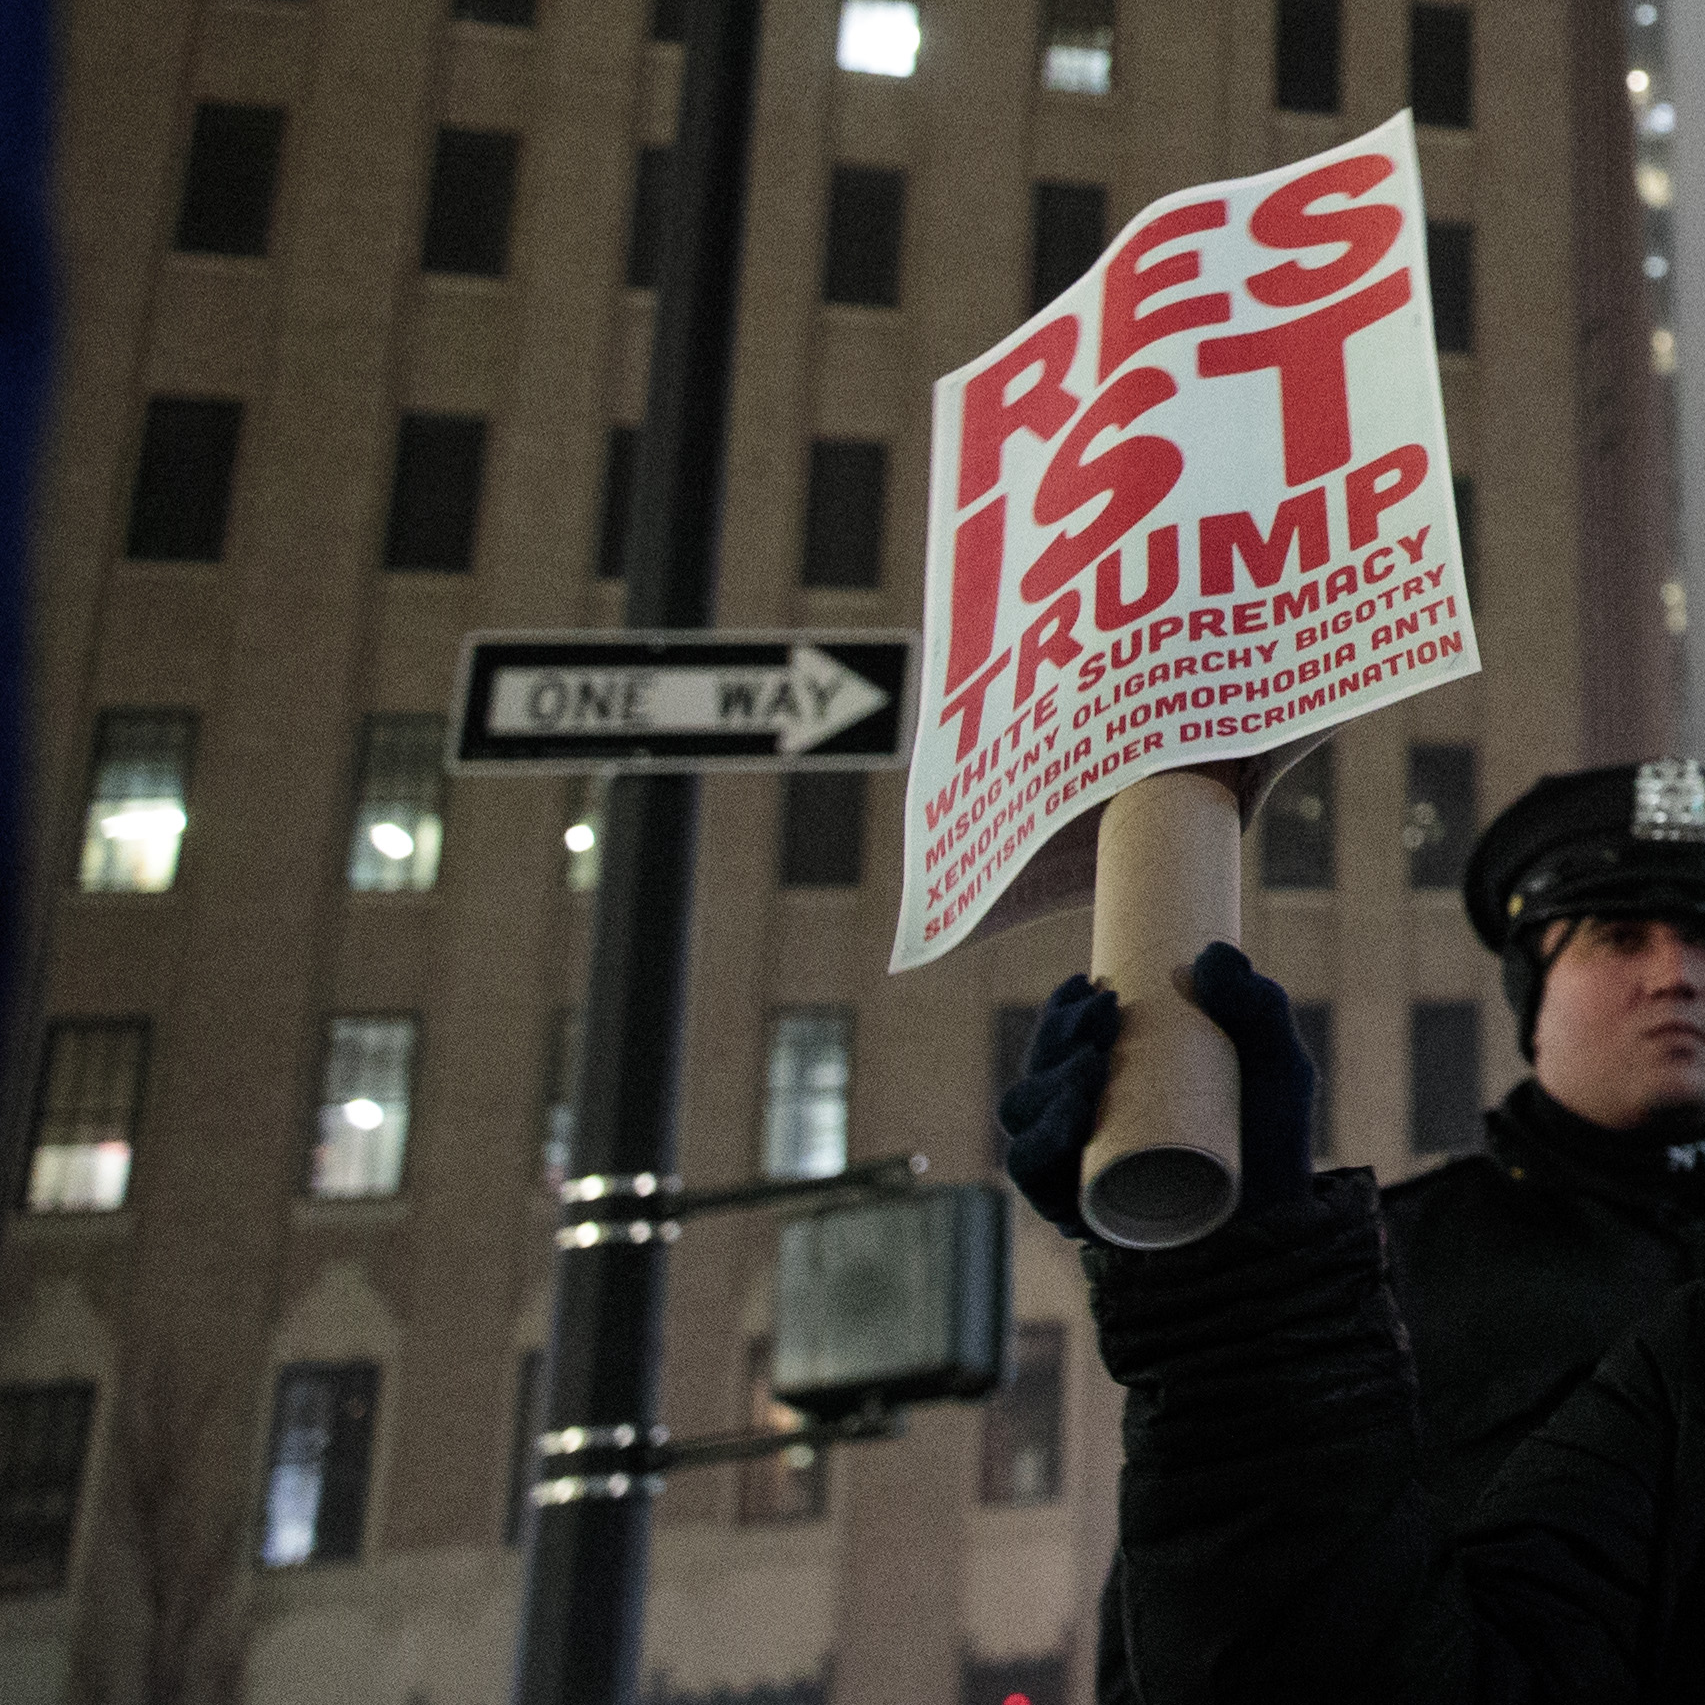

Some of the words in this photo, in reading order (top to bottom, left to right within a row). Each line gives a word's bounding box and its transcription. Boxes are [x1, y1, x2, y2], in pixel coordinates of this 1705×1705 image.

[943, 266, 1413, 696] IST
[955, 152, 1406, 510] RES
[527, 674, 651, 727] ONE
[717, 674, 845, 725] WAY
[924, 683, 1059, 830] WHITE
[1076, 525, 1431, 693] SUPREMACY
[924, 724, 1060, 873] MISOGYNY
[1072, 640, 1279, 730] OLIGARCHY
[1295, 563, 1446, 651] BIGOTRY
[925, 736, 1092, 910] XENOPHOBIA
[1106, 642, 1356, 743] HOMOPHOBIA
[1371, 595, 1457, 651] ANTI
[938, 443, 1430, 764] TRUMP
[924, 814, 1036, 942] SEMITISM
[1045, 731, 1164, 816] GENDER
[1179, 631, 1463, 743] DISCRIMINATION
